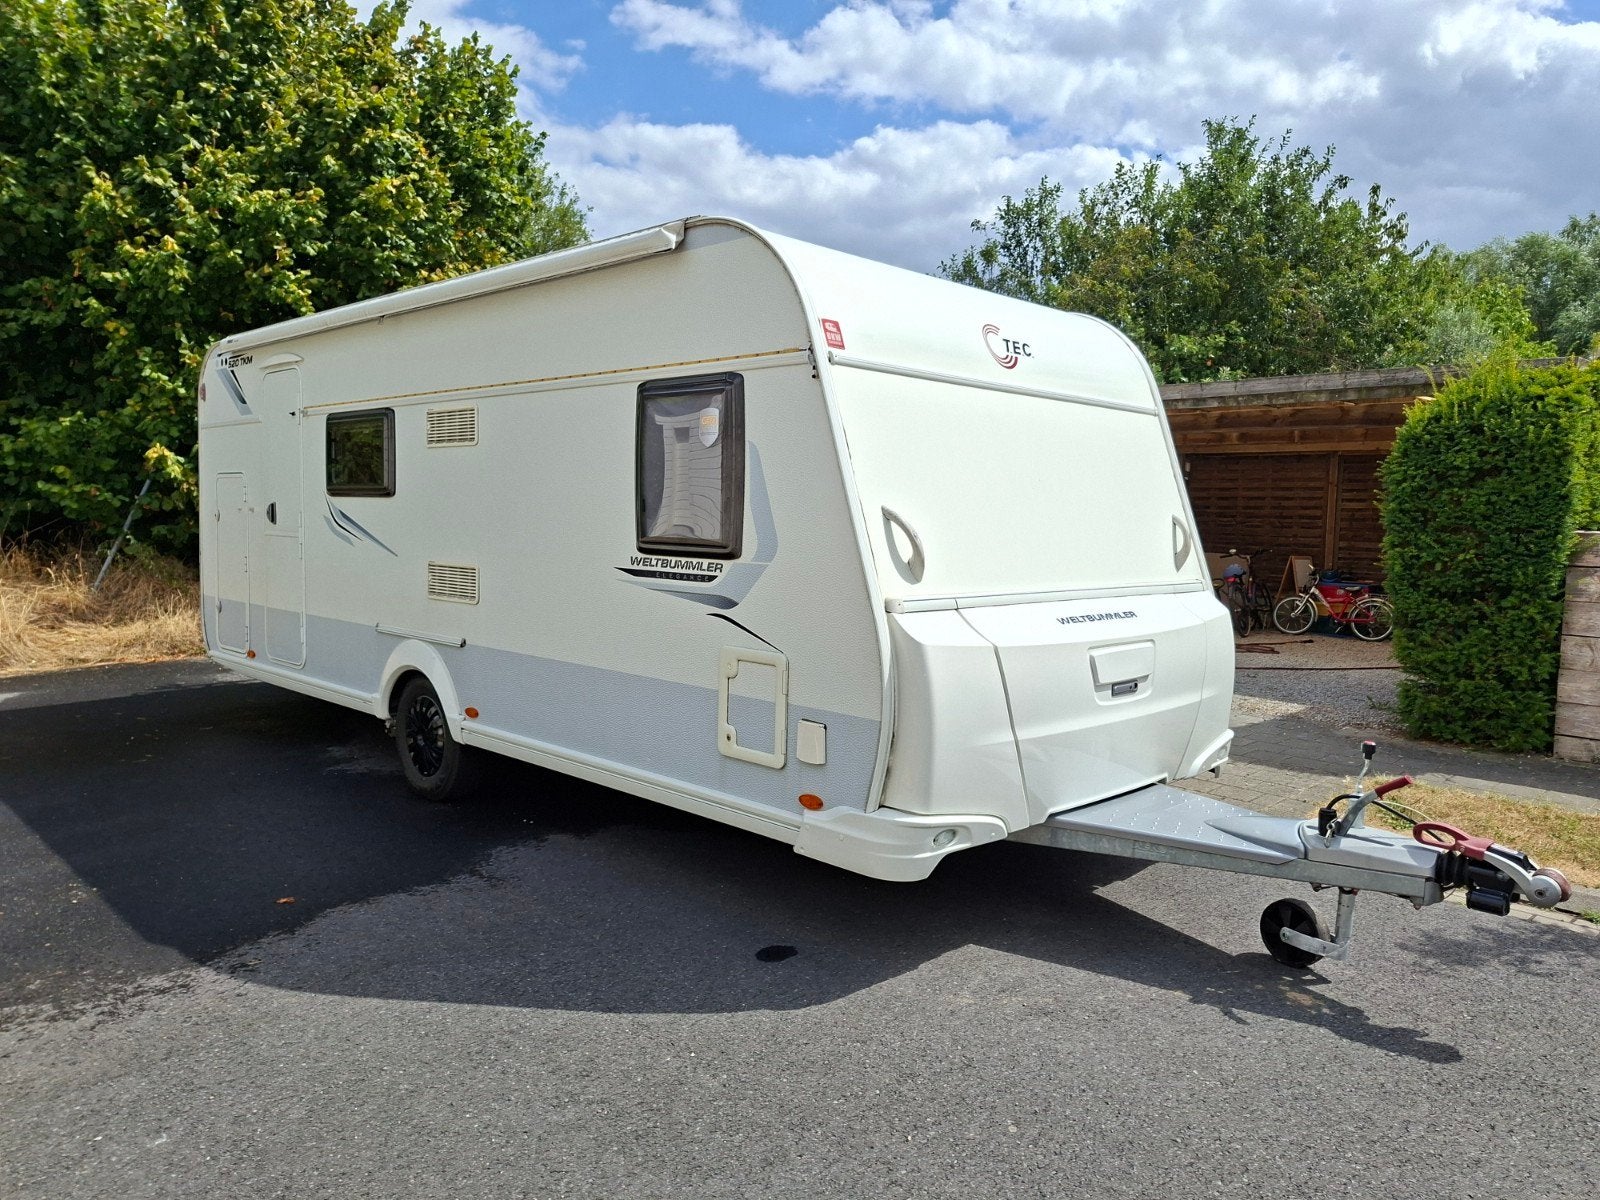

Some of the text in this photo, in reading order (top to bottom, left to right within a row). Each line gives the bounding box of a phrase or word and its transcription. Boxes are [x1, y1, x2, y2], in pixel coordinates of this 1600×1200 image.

[240, 355, 253, 366] TKM
[630, 556, 724, 573] WELTBUMMLER
[655, 571, 710, 582] ELEGANCE
[1056, 611, 1138, 625] WELTBUMMLER
